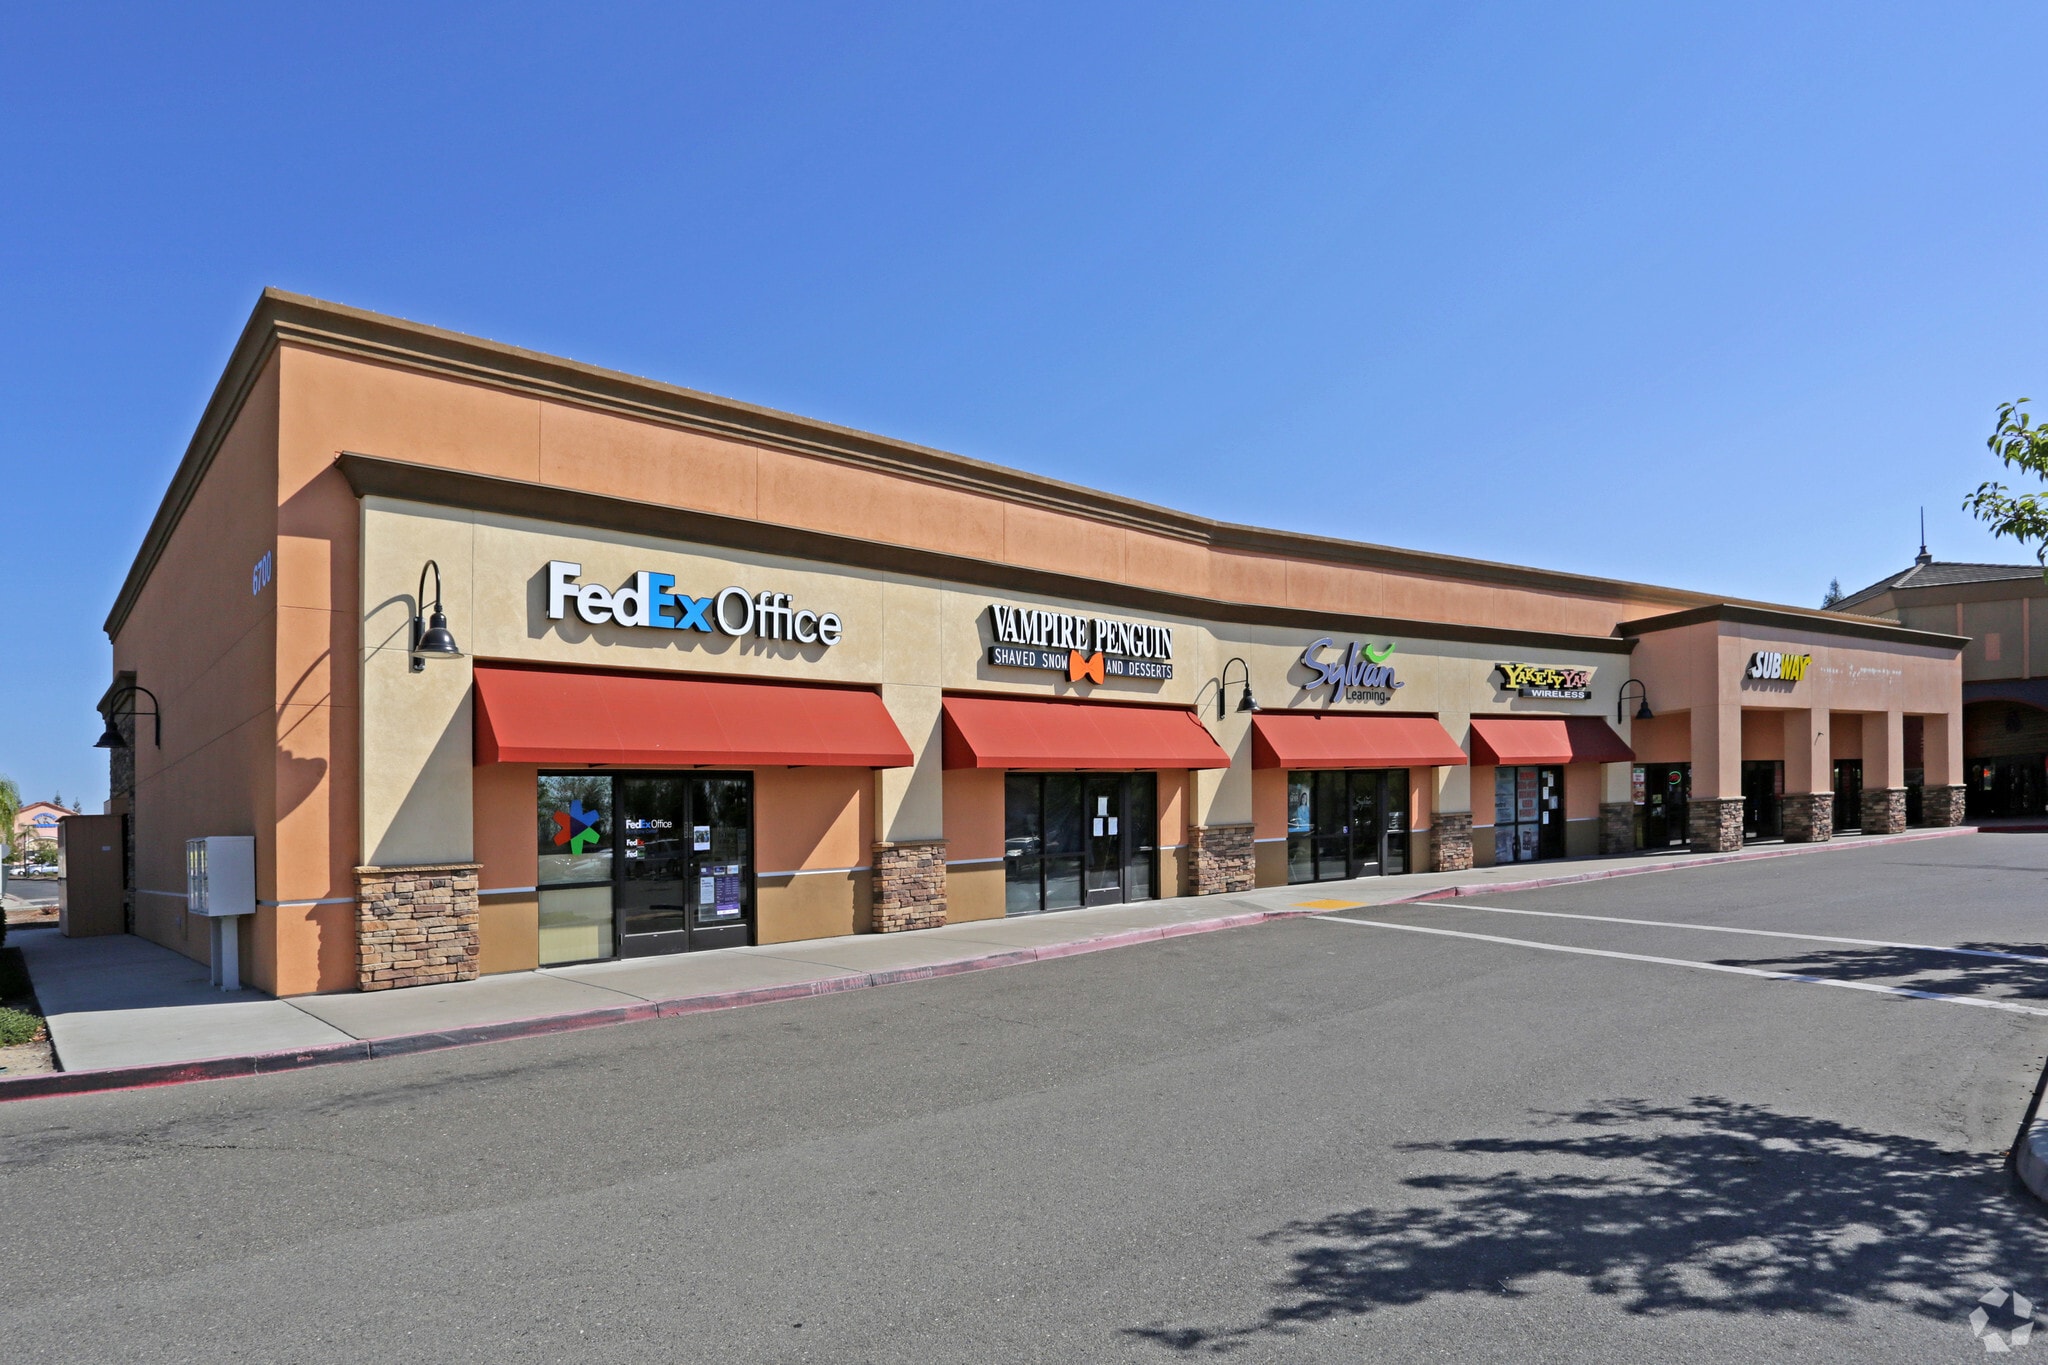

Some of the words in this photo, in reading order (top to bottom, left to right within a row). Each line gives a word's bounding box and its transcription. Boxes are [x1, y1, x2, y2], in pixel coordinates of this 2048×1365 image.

[252, 549, 272, 596] 6700
[548, 560, 713, 633] FedEx
[715, 585, 843, 646] Office
[992, 604, 1089, 650] VAMPIRE
[1094, 618, 1173, 660] PENGUIN
[994, 648, 1036, 667] SHAVED
[1042, 653, 1068, 670] SNOW
[1105, 659, 1124, 675] AND
[1128, 662, 1172, 679] DESSERTS
[1304, 637, 1405, 703] Sylvan
[1500, 663, 1564, 689] YAKETY
[1561, 670, 1592, 688] YAK
[1750, 651, 1812, 681] SUBWAY
[1345, 687, 1386, 704] Learning
[1531, 689, 1586, 699] WIRELESS
[625, 819, 651, 829] FedEx
